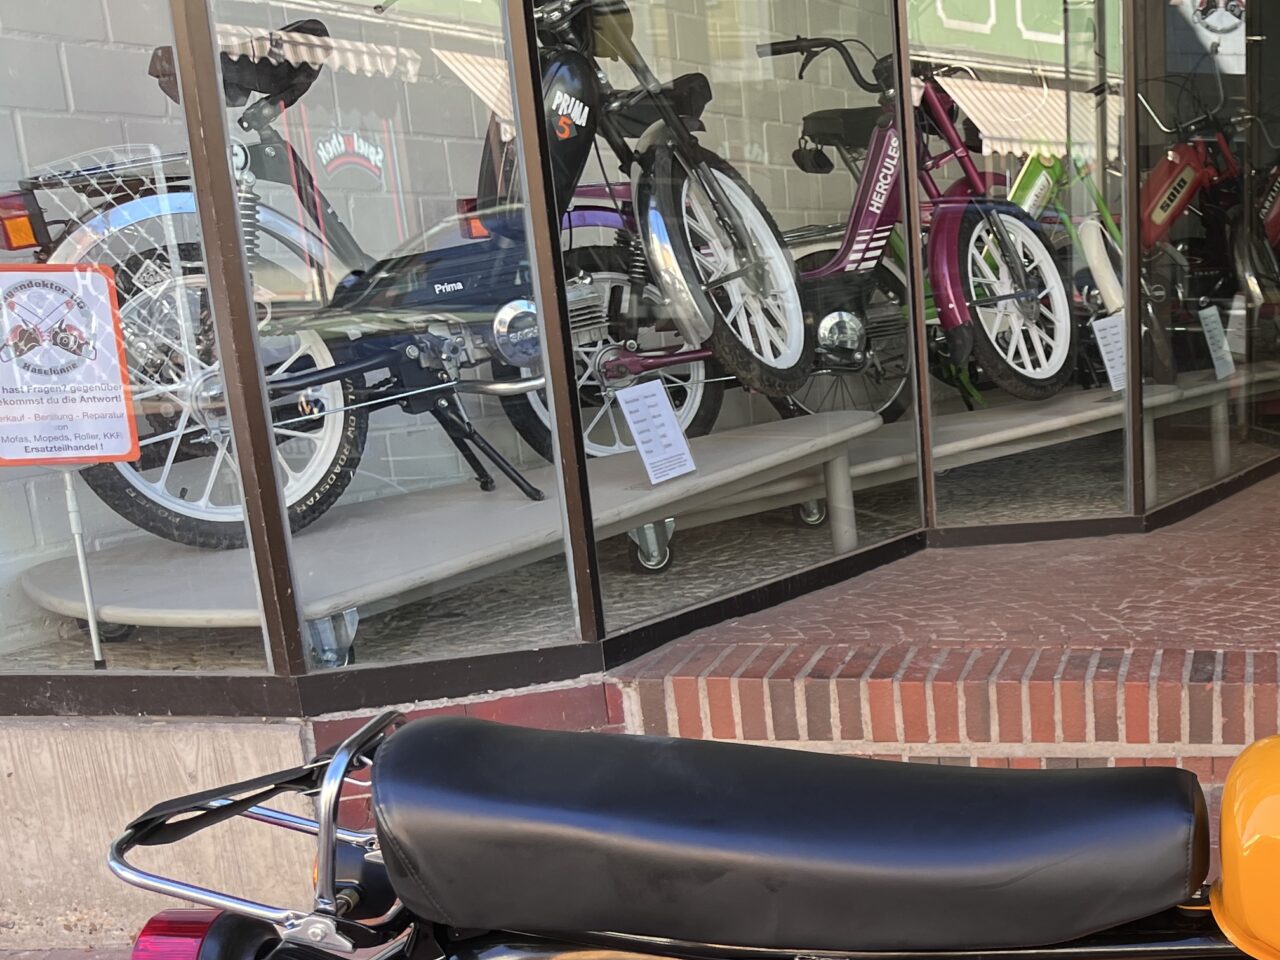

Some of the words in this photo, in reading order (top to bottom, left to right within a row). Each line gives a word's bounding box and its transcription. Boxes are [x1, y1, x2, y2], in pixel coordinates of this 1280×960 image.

[552, 90, 590, 127] PRIMA
[556, 115, 572, 139] 5
[1159, 177, 1188, 214] solo
[434, 281, 464, 295] Prima
[2, 387, 25, 395] hast
[27, 383, 67, 395] Fragen?
[47, 396, 59, 405] du
[62, 395, 77, 404] die
[80, 393, 121, 404] Antwort!
[34, 433, 72, 443] Mopeds,
[74, 432, 101, 441] Roller,
[24, 443, 99, 454] Ersatzteilhandel
